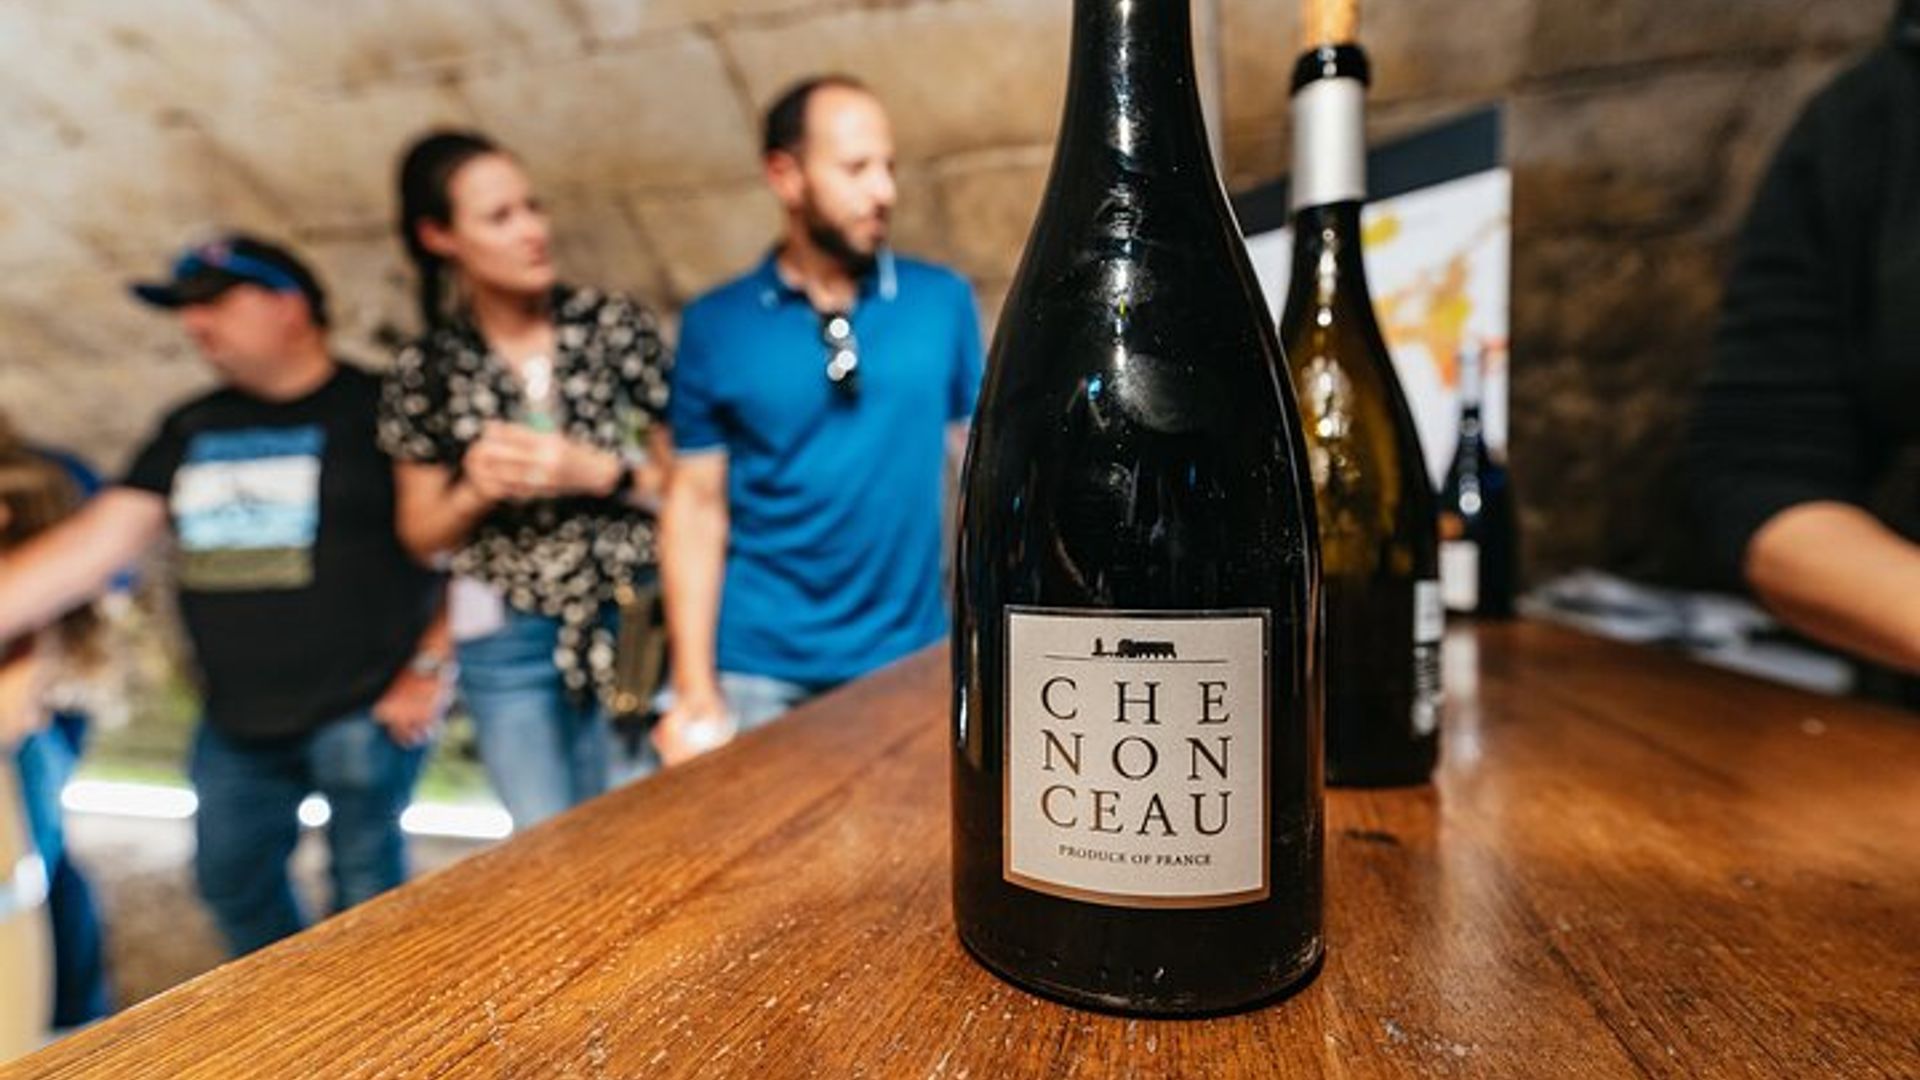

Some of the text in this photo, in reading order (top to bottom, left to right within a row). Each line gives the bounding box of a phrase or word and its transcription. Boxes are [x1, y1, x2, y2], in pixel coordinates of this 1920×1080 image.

[1040, 785, 1232, 836] CEAU
[1058, 844, 1211, 866] PRODUCE OF FRANCE
